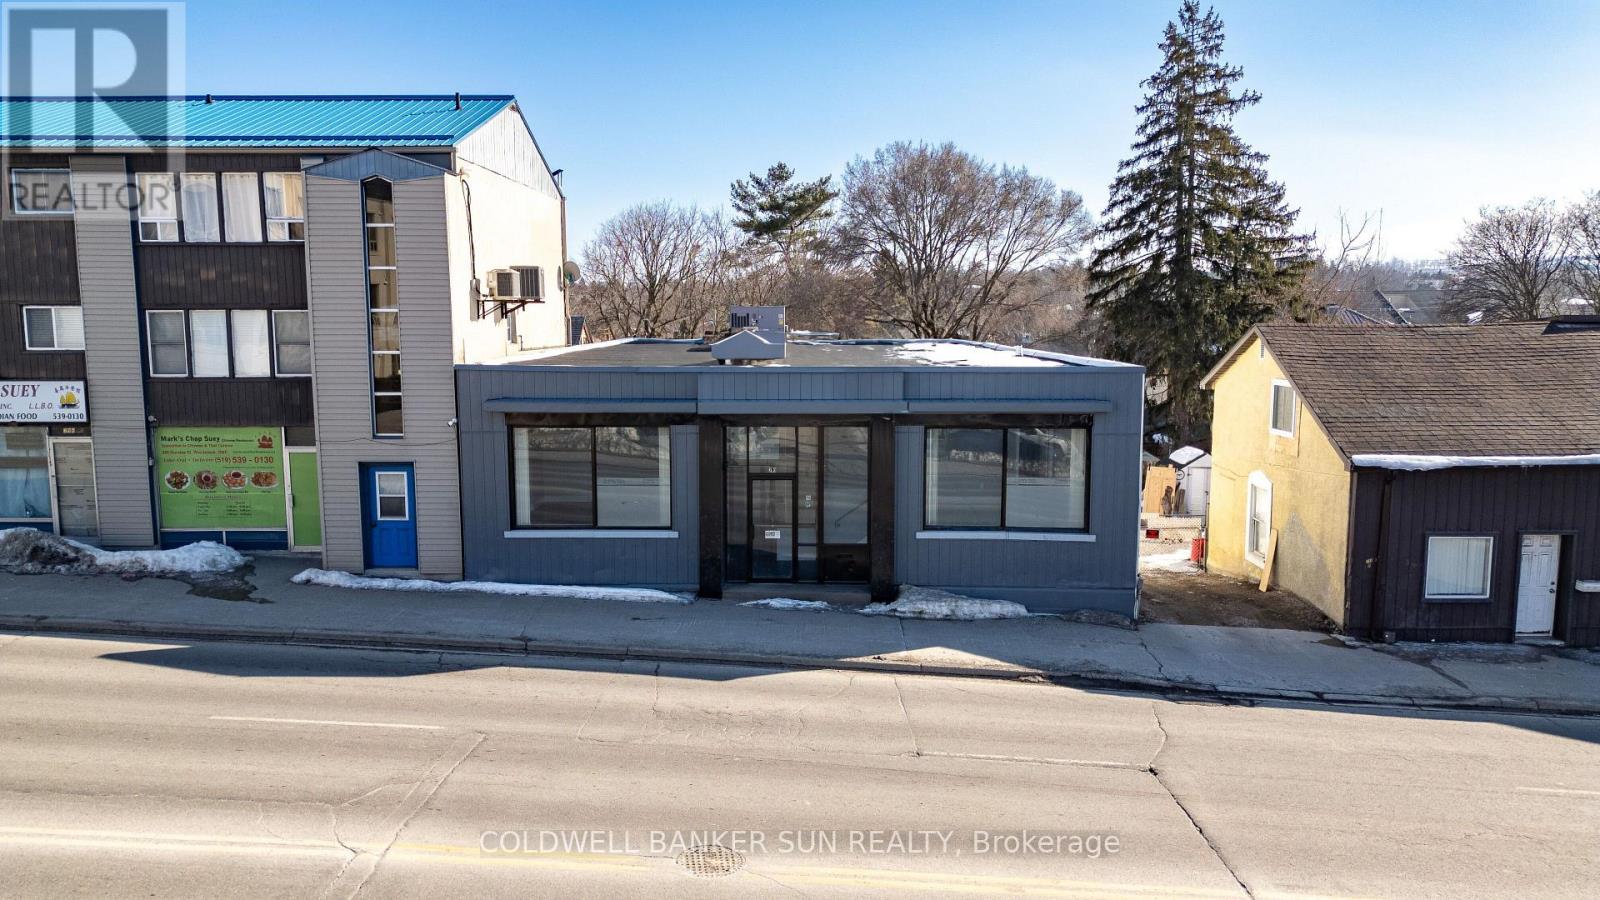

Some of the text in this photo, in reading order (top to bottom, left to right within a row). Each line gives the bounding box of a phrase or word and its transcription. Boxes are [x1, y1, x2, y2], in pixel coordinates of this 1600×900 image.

[0, 384, 40, 398] SUEY
[16, 412, 38, 420] FOOD
[52, 412, 84, 420] 539-0130
[185, 435, 202, 443] Chop
[203, 435, 220, 443] Suey
[232, 456, 247, 464] 539
[254, 456, 274, 464] 0130
